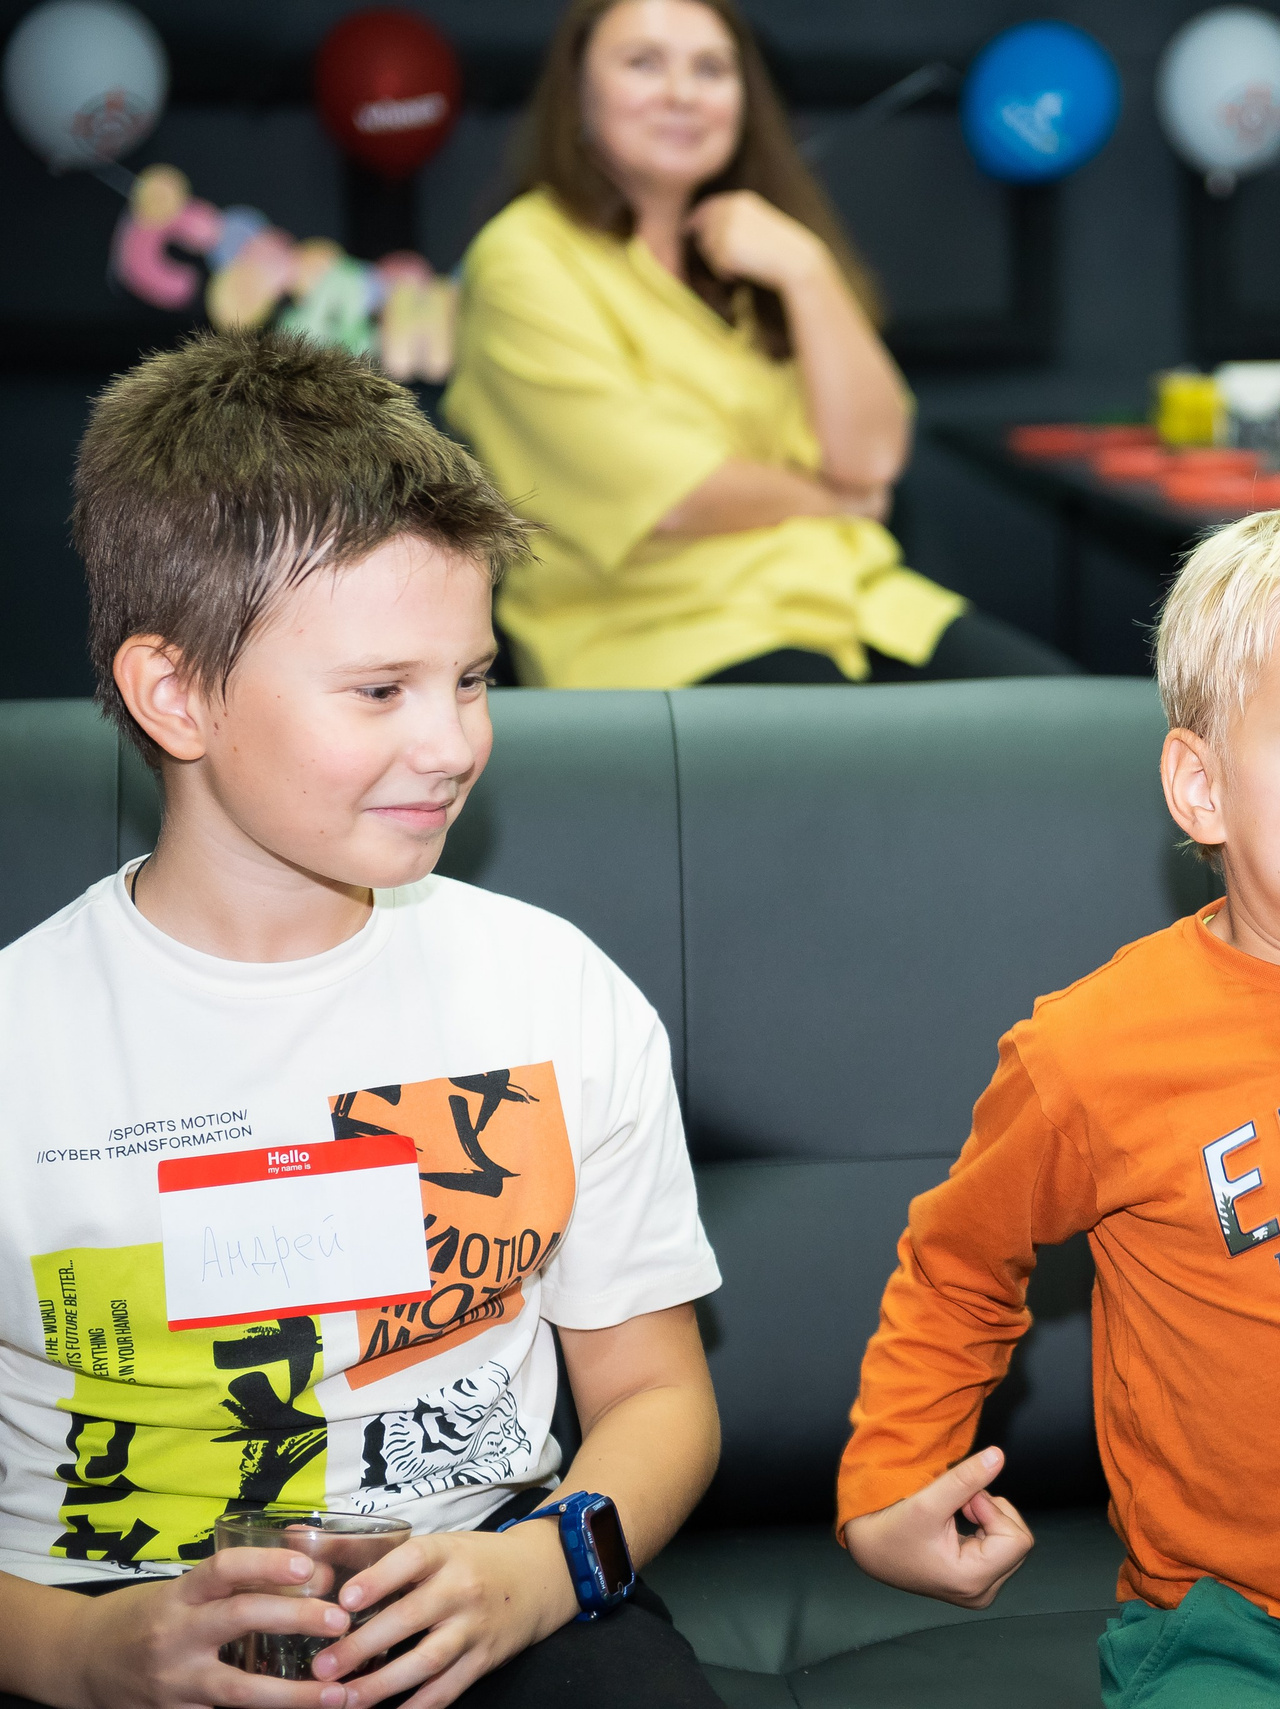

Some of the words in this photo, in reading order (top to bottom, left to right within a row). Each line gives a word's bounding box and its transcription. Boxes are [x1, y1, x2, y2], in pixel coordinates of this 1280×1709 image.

[109, 1120, 177, 1142] /SPORTS
[181, 1109, 248, 1131] MOTION/
[37, 1148, 102, 1164] //CYBER
[105, 1124, 253, 1159] TRANSFORMATION
[267, 1149, 310, 1166] Hello
[268, 1167, 280, 1175] my
[281, 1164, 303, 1172] name
[202, 1213, 344, 1289] Андрей
[39, 1299, 58, 1335] WORLD
[65, 1308, 80, 1350] FUTURE
[111, 1299, 131, 1335] HANDS!
[45, 1337, 59, 1356] THE
[117, 1335, 135, 1364] YOUR
[119, 1364, 135, 1377] IN
